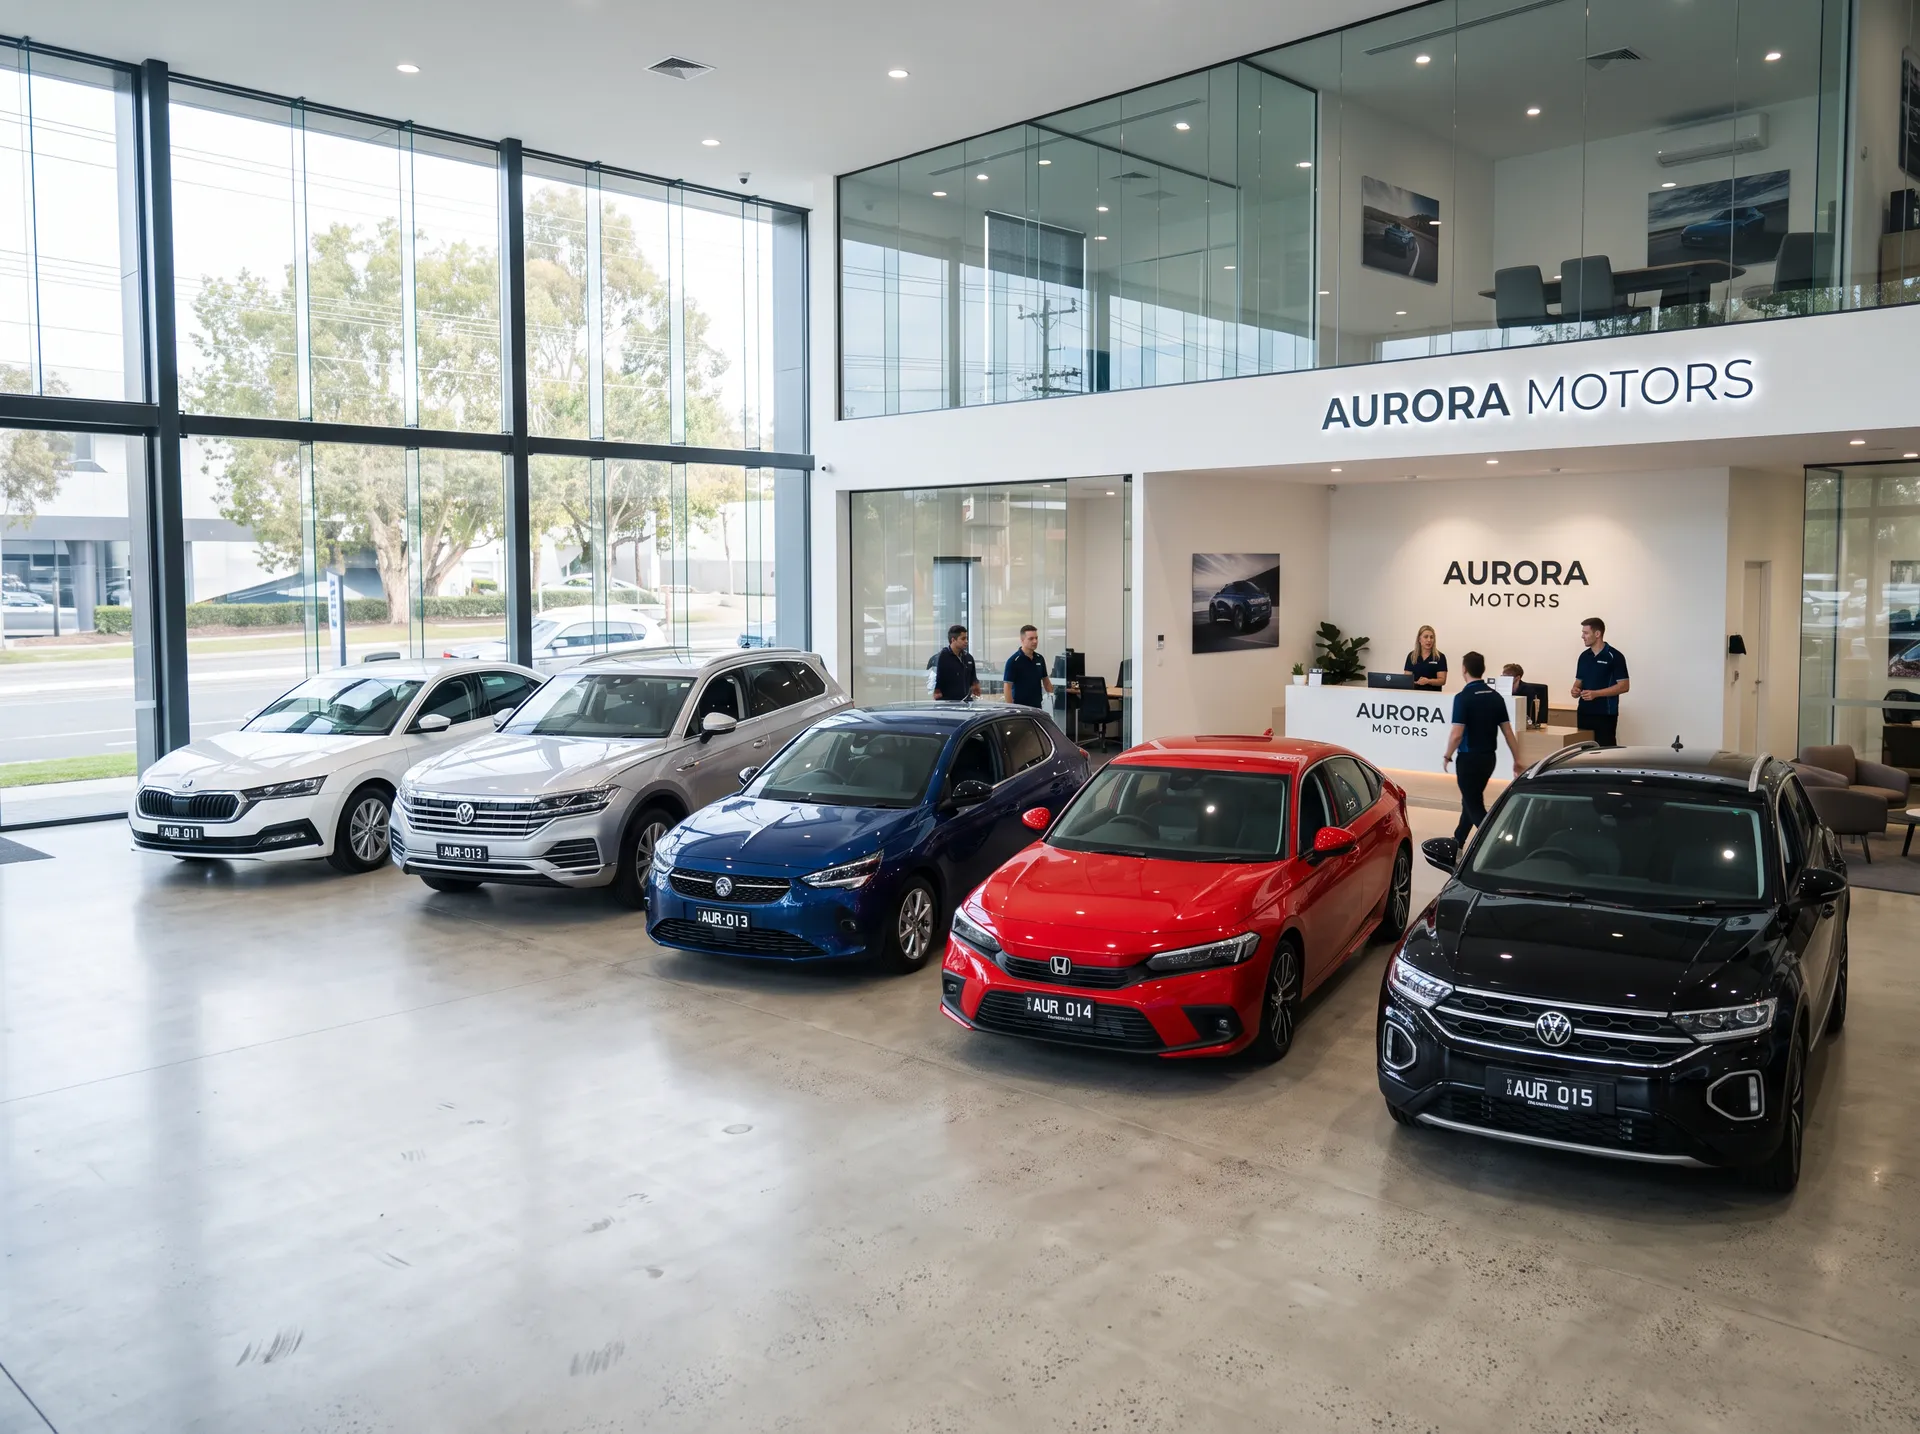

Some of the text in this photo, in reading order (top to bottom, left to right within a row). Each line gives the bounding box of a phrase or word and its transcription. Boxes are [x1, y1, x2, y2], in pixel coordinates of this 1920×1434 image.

[1322, 359, 1754, 430] AURORA MOTORS
[1443, 560, 1590, 586] AURORA
[1469, 593, 1560, 608] MOTORS
[1356, 702, 1446, 724] AURORA
[1372, 723, 1428, 737] MOTORS
[164, 827, 180, 838] AUR
[183, 828, 199, 839] 011
[1033, 997, 1059, 1015] AUR
[1065, 1002, 1092, 1019] 014
[1513, 1079, 1548, 1101] AUR
[1557, 1086, 1593, 1107] 015
